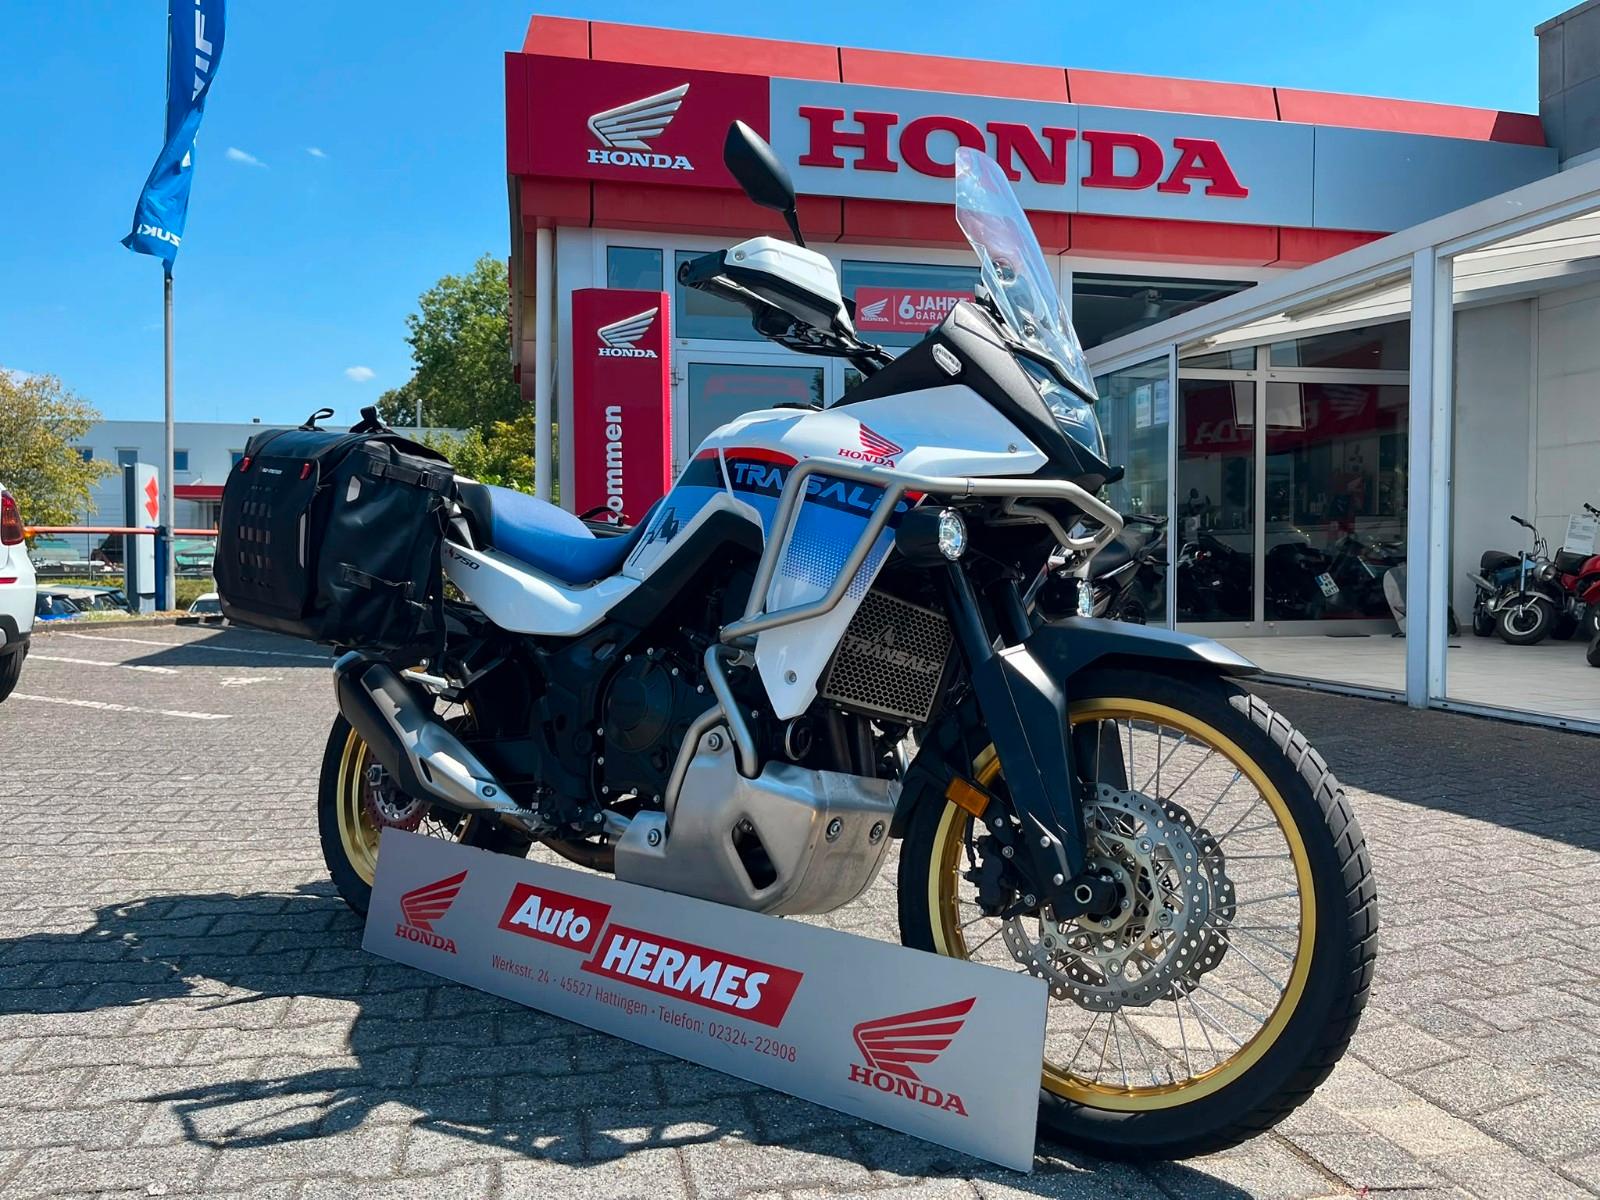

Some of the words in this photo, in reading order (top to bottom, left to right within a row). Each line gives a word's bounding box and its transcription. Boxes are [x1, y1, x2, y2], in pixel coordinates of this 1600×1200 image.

[192, 0, 213, 101] IF
[587, 149, 695, 171] HONDA
[799, 106, 1249, 198] HONDA
[898, 295, 916, 319] 6
[915, 295, 970, 312] JAHR
[915, 310, 948, 321] GARA
[598, 347, 658, 359] HONDA
[605, 405, 624, 525] ommen
[838, 448, 896, 468] HONDA
[734, 463, 909, 513] TRASALP
[845, 635, 941, 674] TRANSALP
[395, 923, 457, 954] HONDA
[509, 895, 591, 943] Auto
[601, 934, 770, 1010] HERMES
[492, 954, 534, 980] Werksstr.
[538, 968, 549, 985] 24
[560, 976, 593, 1000] 45527
[595, 985, 648, 1016] Hattingen
[659, 1005, 705, 1034] Telefon:
[708, 1022, 796, 1063] 02324-22908
[848, 1063, 968, 1117] HONDA
